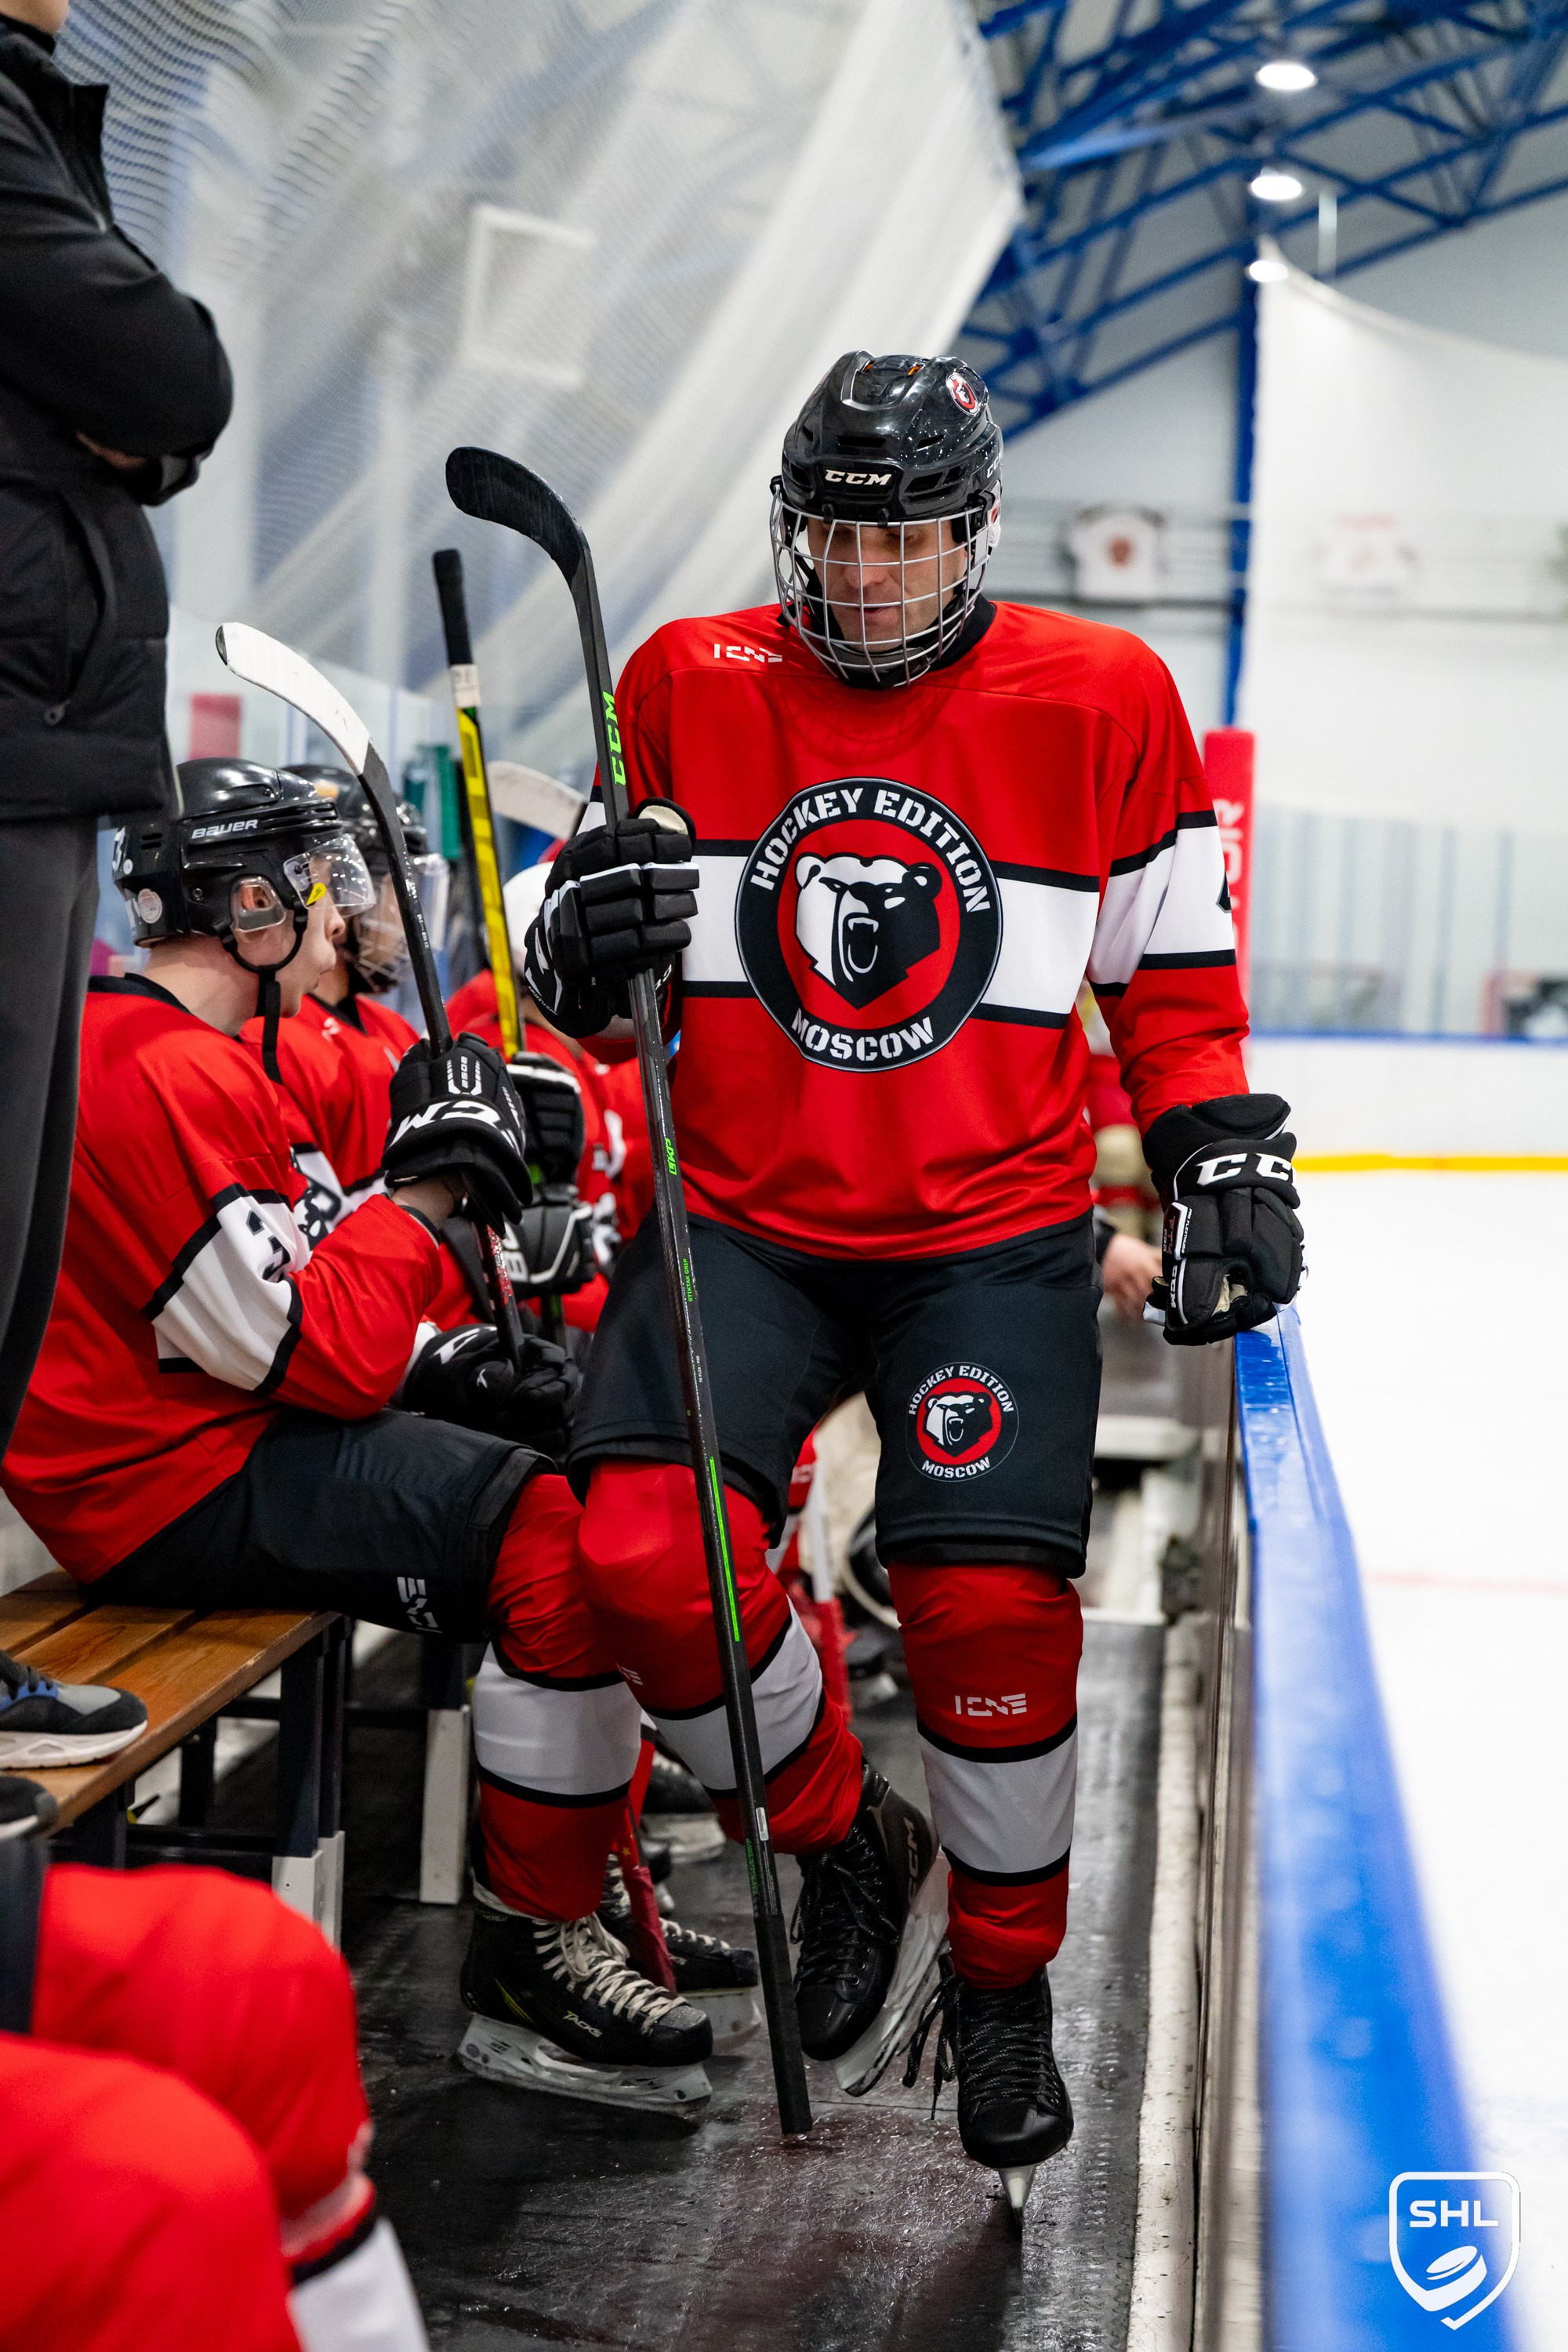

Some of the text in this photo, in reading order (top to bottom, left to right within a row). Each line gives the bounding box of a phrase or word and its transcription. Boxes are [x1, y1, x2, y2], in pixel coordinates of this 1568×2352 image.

[824, 469, 892, 486] CCM
[602, 691, 626, 786] CCM
[191, 818, 259, 840] BAUER
[750, 786, 991, 913] HOCKEY EDITION
[790, 1006, 935, 1062] MOSCOW
[1196, 1152, 1293, 1187] CC
[684, 1275, 693, 1302] STIKTAK
[908, 1365, 1014, 1416] HOCKEY EDITION
[920, 1456, 991, 1479] MOSCOW
[563, 2009, 604, 2038] TACKS
